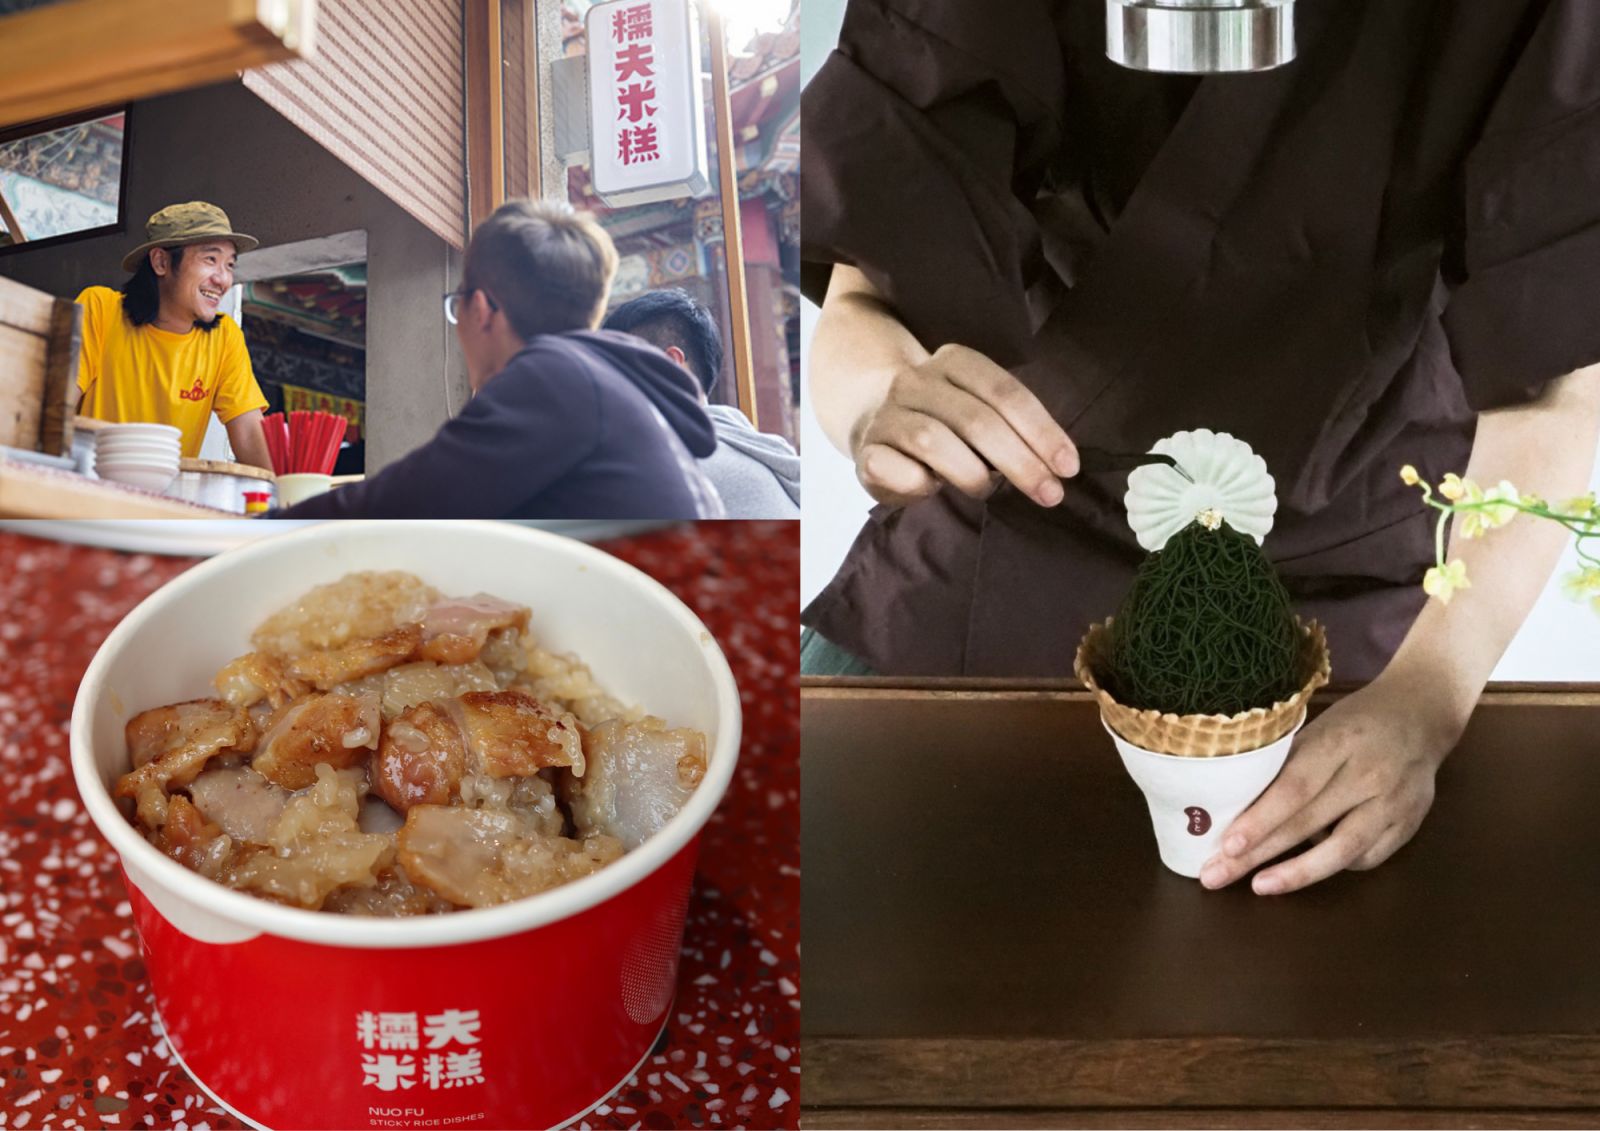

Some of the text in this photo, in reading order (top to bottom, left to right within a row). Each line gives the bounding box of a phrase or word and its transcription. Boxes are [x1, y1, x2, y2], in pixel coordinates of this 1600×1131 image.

[612, 3, 660, 166] 糯夫米糕
[356, 1009, 481, 1050] 糯夫
[361, 1048, 485, 1091] 米糕
[368, 1106, 425, 1117] NUO FU
[369, 1112, 485, 1127] STICKY RICE DISHES
